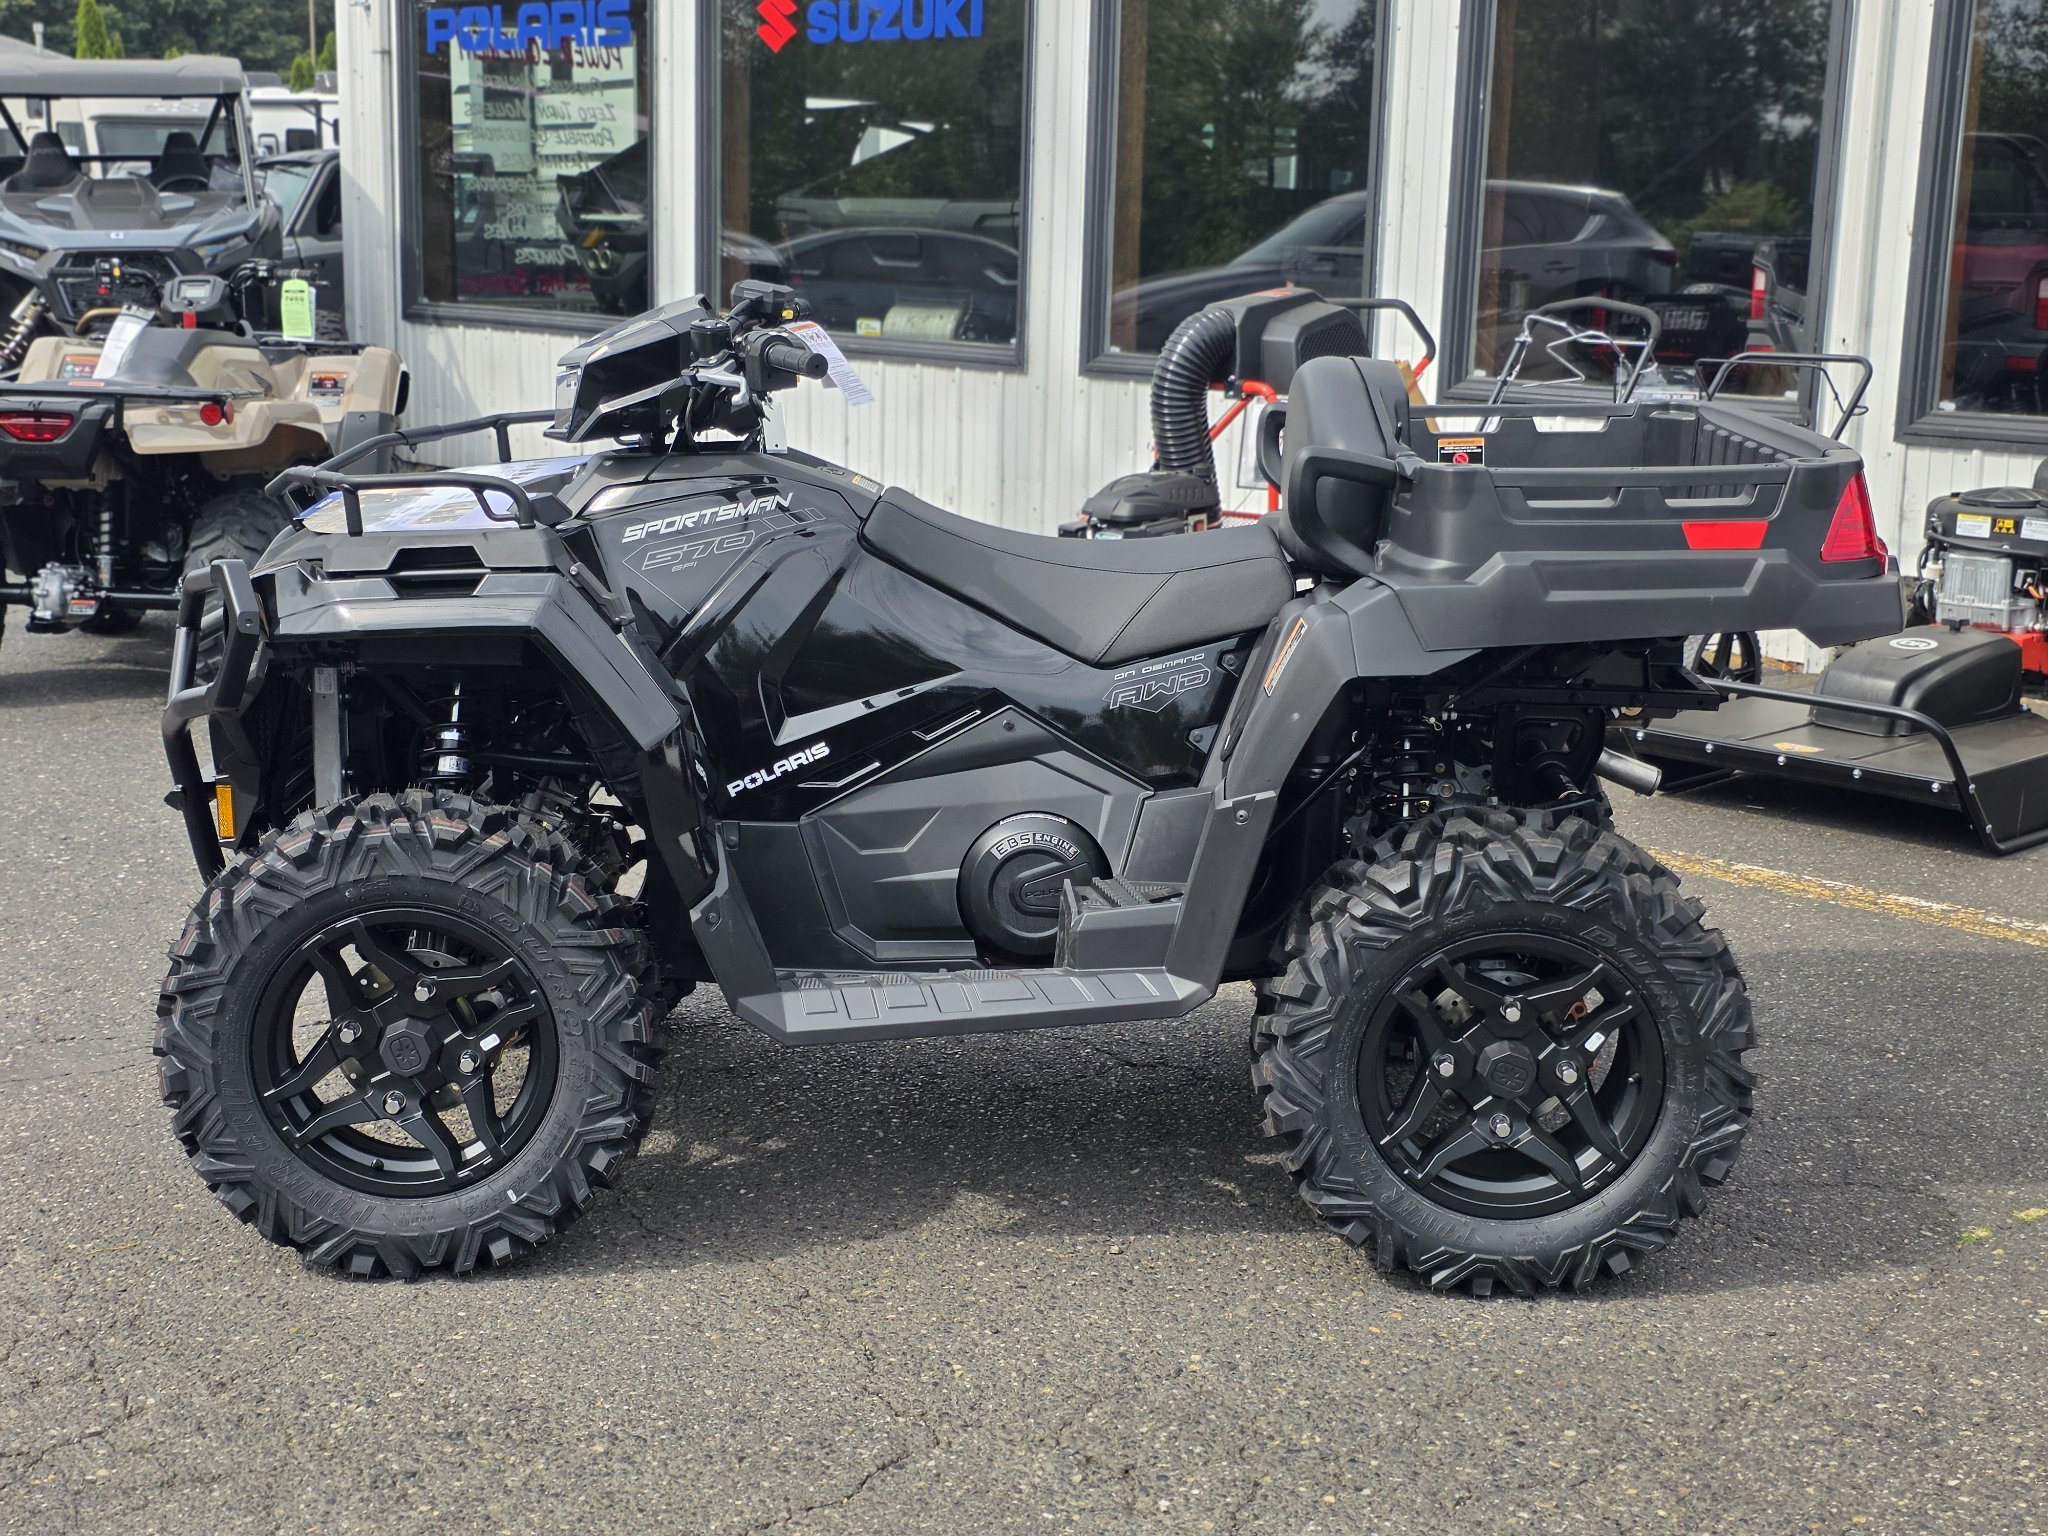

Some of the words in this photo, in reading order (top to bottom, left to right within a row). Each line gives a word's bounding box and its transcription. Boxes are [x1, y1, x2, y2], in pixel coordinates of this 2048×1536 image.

[426, 0, 632, 54] POLARIS
[806, 0, 984, 44] SUZUKI
[621, 493, 794, 544] SPORTSMAN
[641, 529, 756, 571] 570
[1114, 670, 1136, 681] ON
[1141, 653, 1205, 674] DEMAND
[1109, 668, 1211, 710] AWD
[727, 741, 831, 798] POLARIS
[995, 834, 1031, 856] EBS
[1034, 832, 1078, 856] ENGINE
